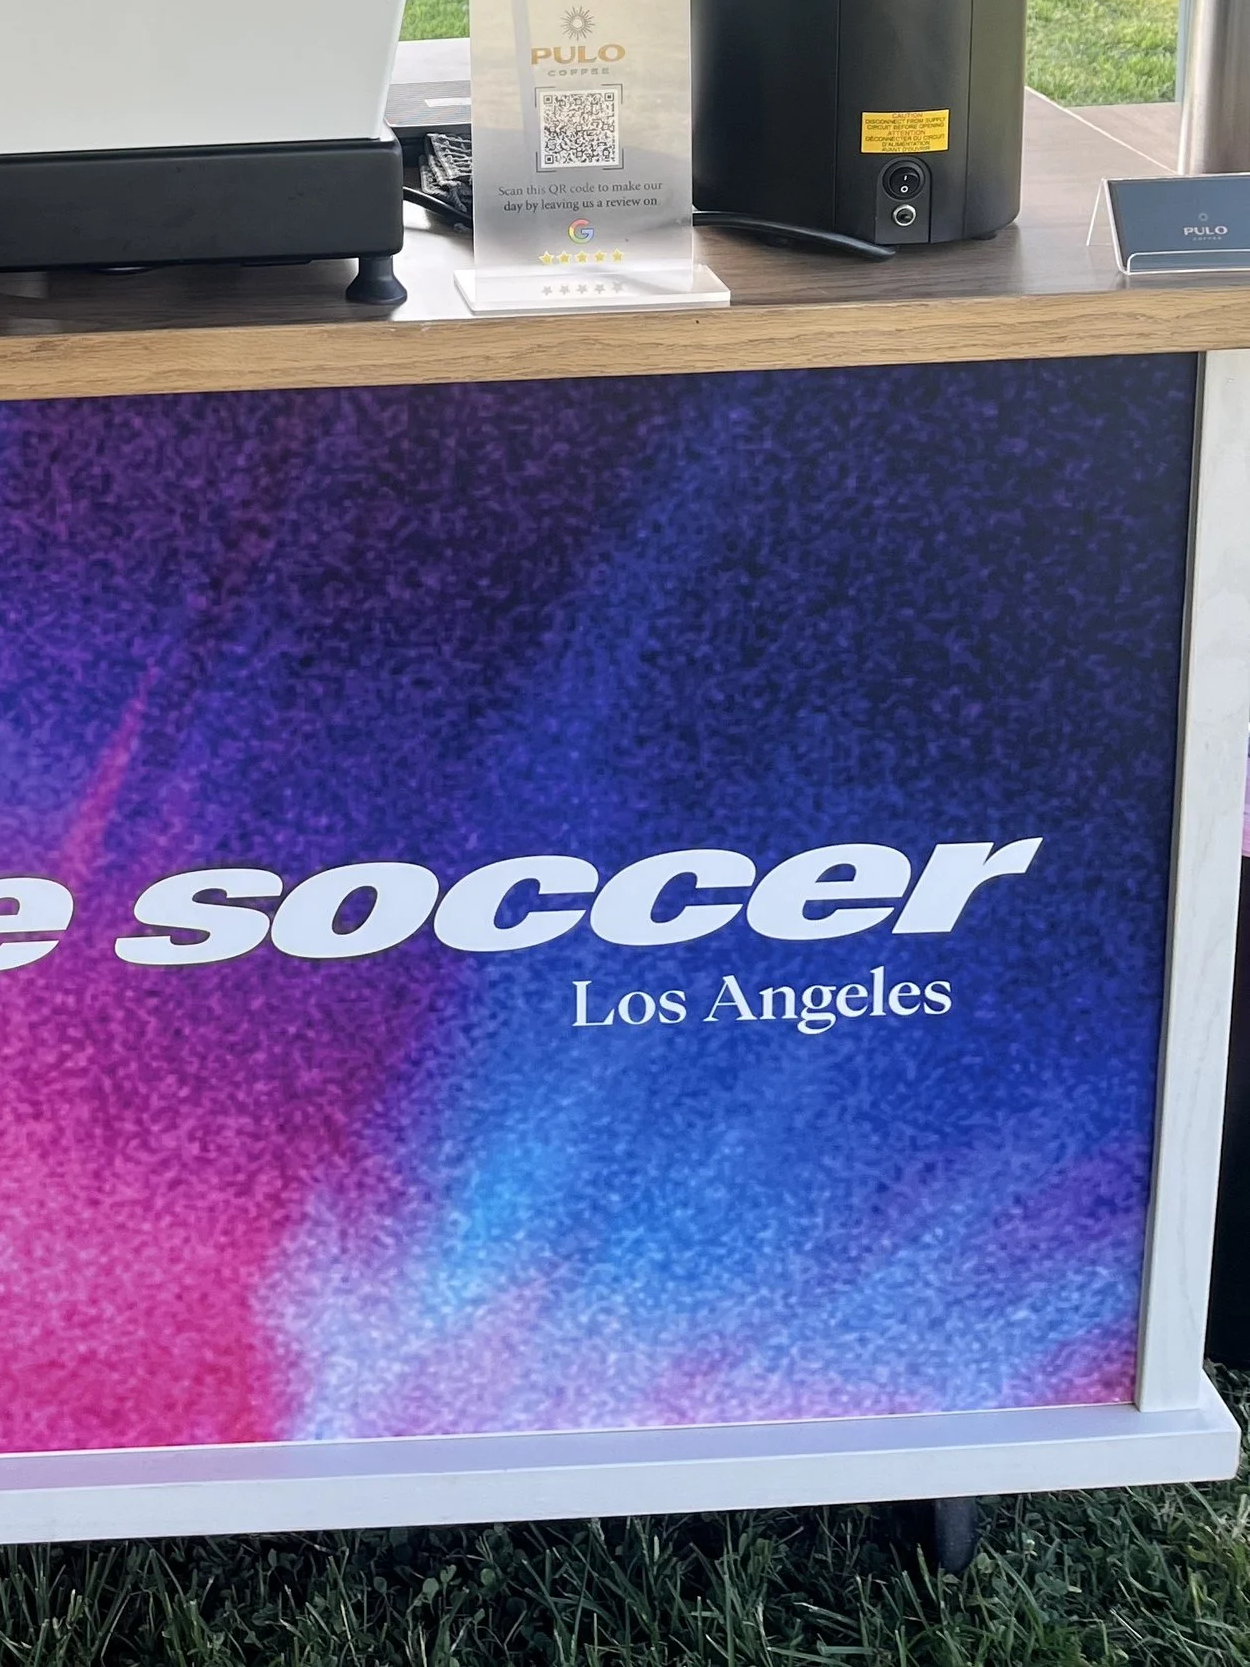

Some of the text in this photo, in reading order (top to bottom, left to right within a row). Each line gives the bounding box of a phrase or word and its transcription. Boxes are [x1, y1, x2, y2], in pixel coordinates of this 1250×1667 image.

[530, 43, 626, 66] PULO
[547, 67, 611, 77] COFFEE
[498, 181, 663, 197] Scan this QR code to make our
[503, 200, 523, 213] day
[525, 200, 538, 213] by
[541, 199, 580, 212] leaving
[582, 200, 595, 209] us
[605, 197, 640, 208] review
[643, 197, 658, 206] on
[1183, 225, 1229, 236] PULO
[114, 837, 1043, 965] soccer
[571, 965, 952, 1035] Los Angeles
